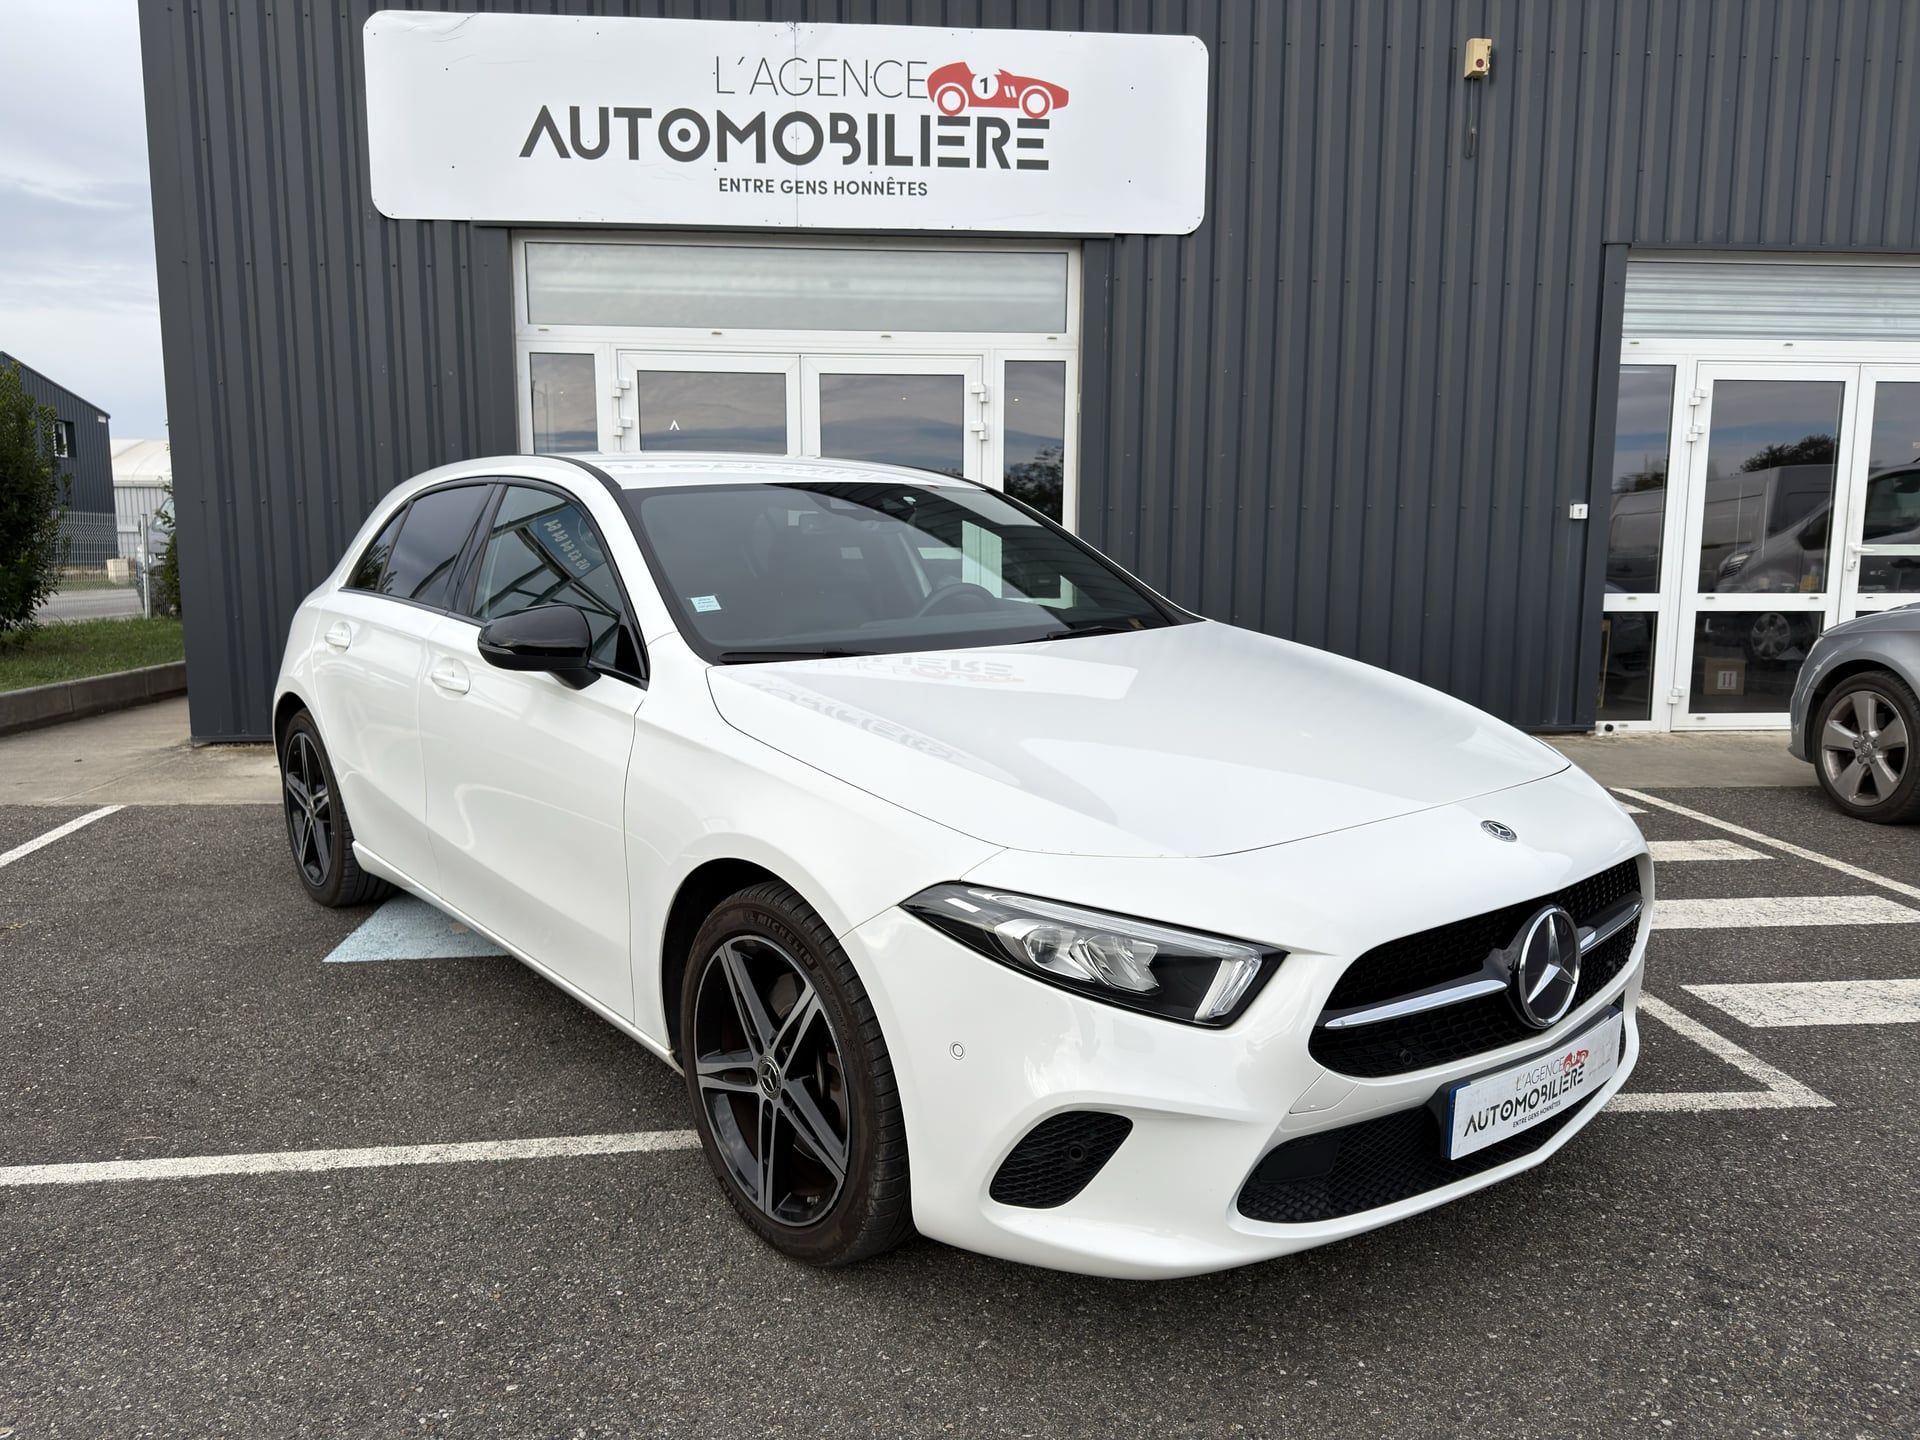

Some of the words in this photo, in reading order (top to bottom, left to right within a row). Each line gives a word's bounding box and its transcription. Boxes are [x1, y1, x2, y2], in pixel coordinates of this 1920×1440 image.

[716, 56, 928, 99] L'AGENCE
[979, 76, 989, 94] 1
[519, 105, 1050, 170] AUTOMOBILIERE
[719, 178, 774, 193] ENTRE
[780, 179, 828, 195] GENS
[834, 177, 928, 196] HONNÊTES
[758, 914, 814, 965] MICHELIN
[1464, 1063, 1585, 1137] AUTOMOBILIERE
[1512, 1116, 1527, 1128] ENTRE
[1528, 1110, 1540, 1121] GENS
